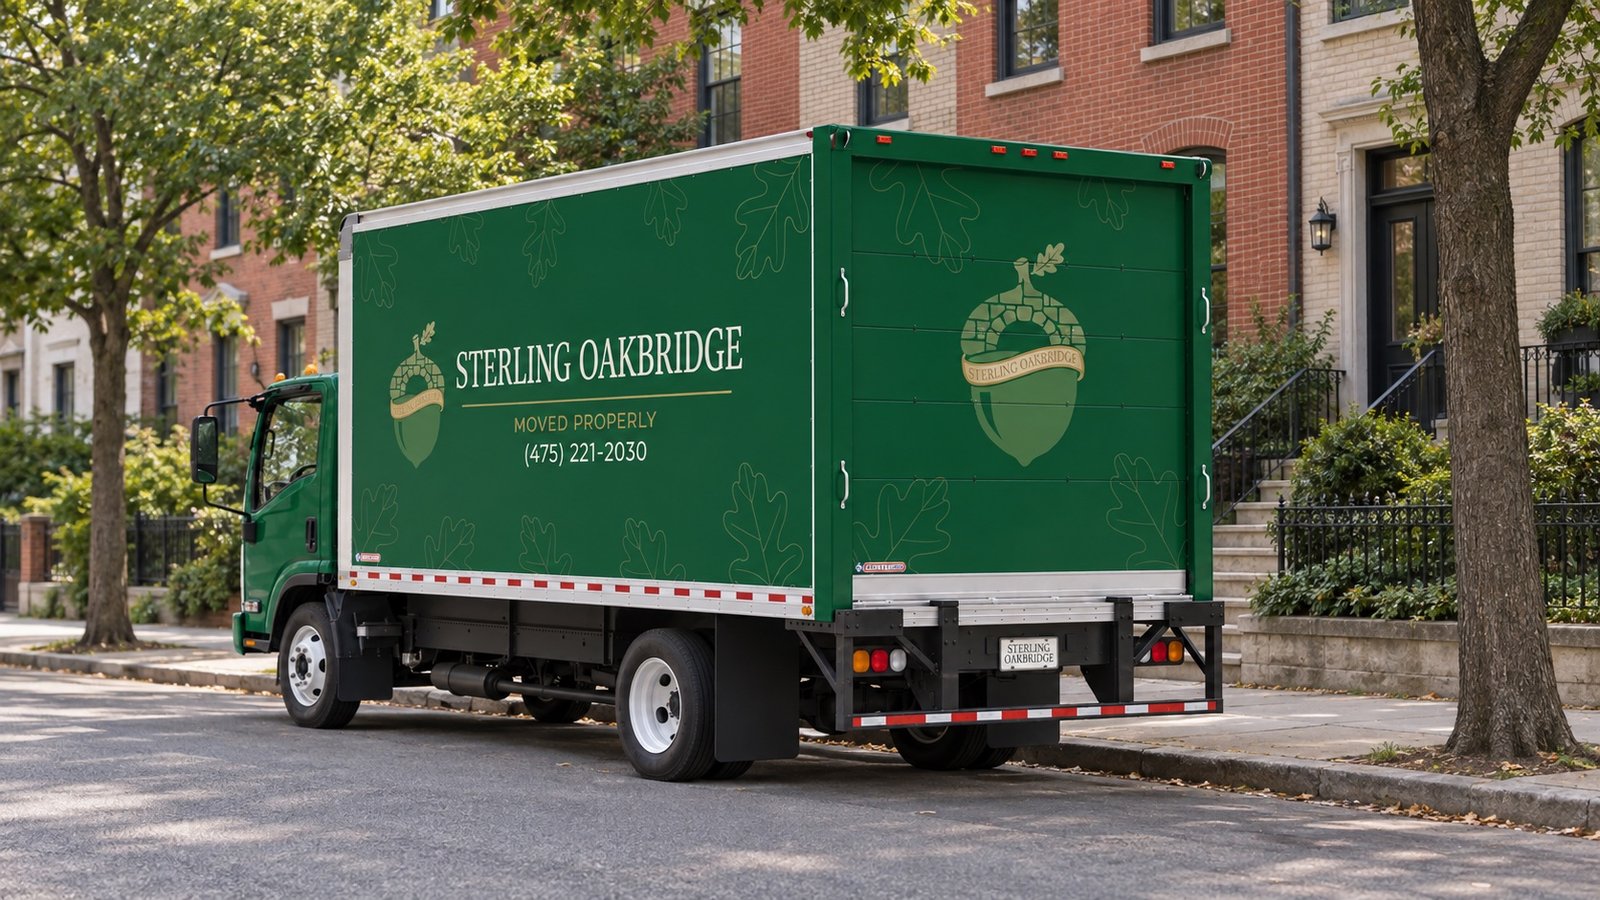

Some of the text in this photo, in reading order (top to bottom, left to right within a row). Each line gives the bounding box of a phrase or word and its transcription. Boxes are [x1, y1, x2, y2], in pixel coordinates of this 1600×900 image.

[456, 325, 743, 390] STERLING OAKBRIDGE
[968, 350, 1077, 381] STERLING OAKBRIDGE
[514, 411, 657, 433] MOVED PROPERLY
[524, 441, 647, 468] (475) 221-2030
[1004, 653, 1054, 664] OAKBRIDGE
[1007, 643, 1050, 653] STERLING
